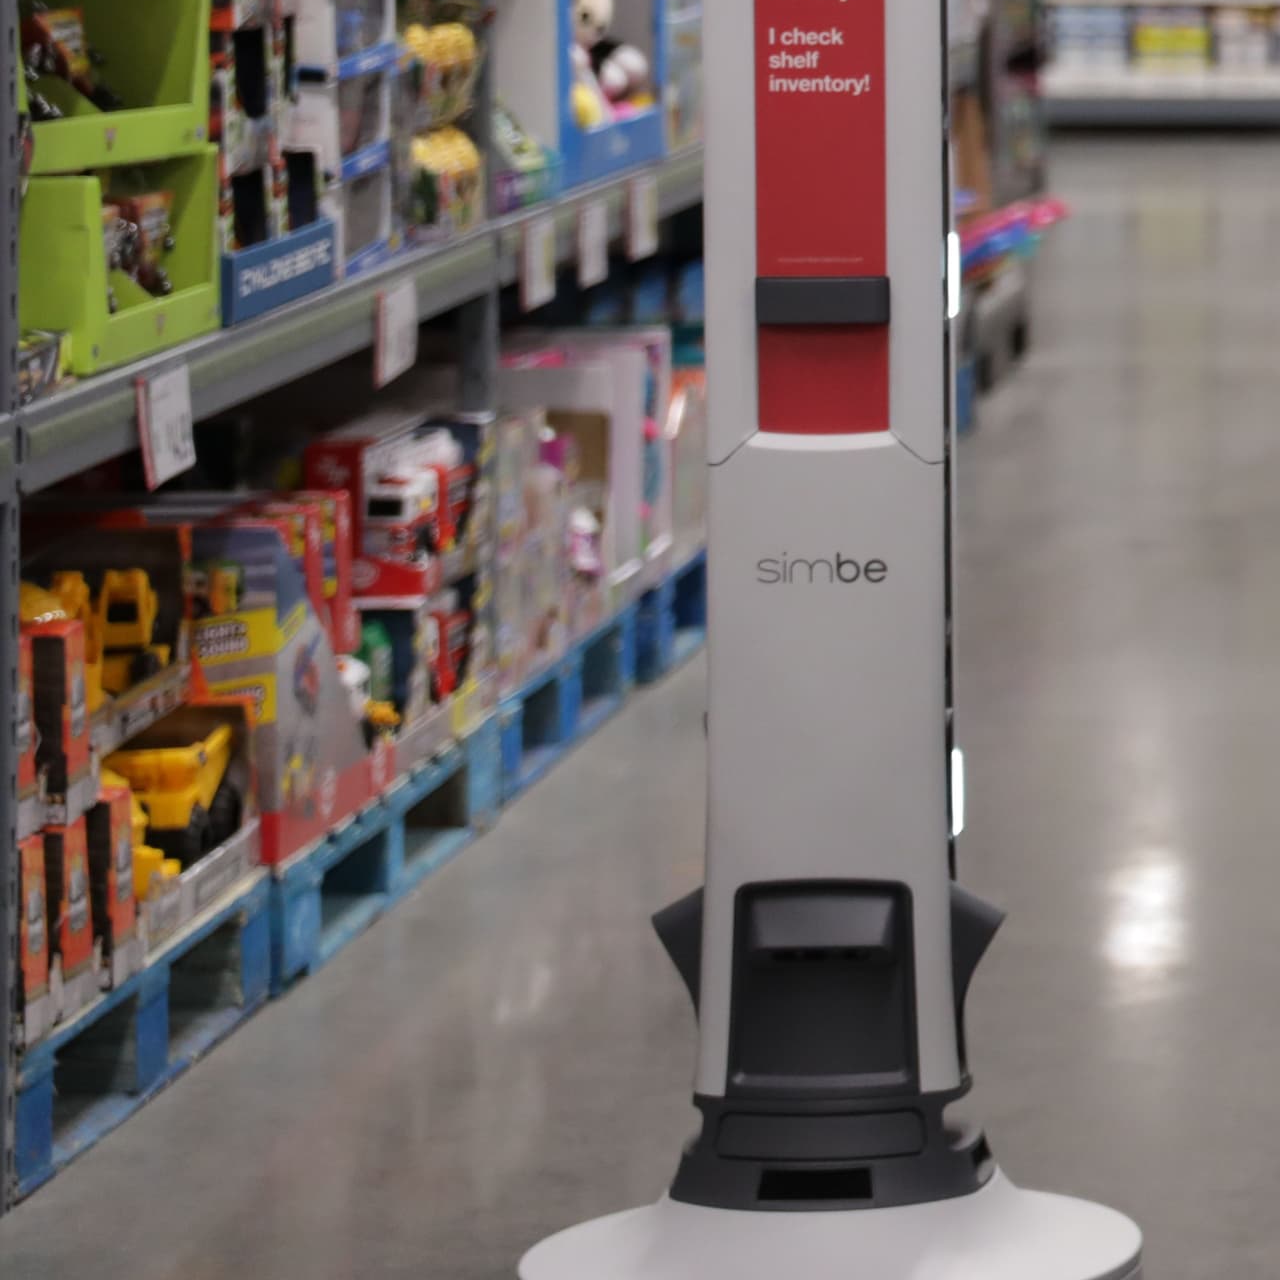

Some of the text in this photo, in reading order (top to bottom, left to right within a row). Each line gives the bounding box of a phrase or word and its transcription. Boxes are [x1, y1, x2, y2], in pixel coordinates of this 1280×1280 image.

[768, 27, 844, 46] I check
[768, 51, 819, 70] shelf
[768, 73, 871, 96] inventory!
[756, 551, 888, 584] simbe
